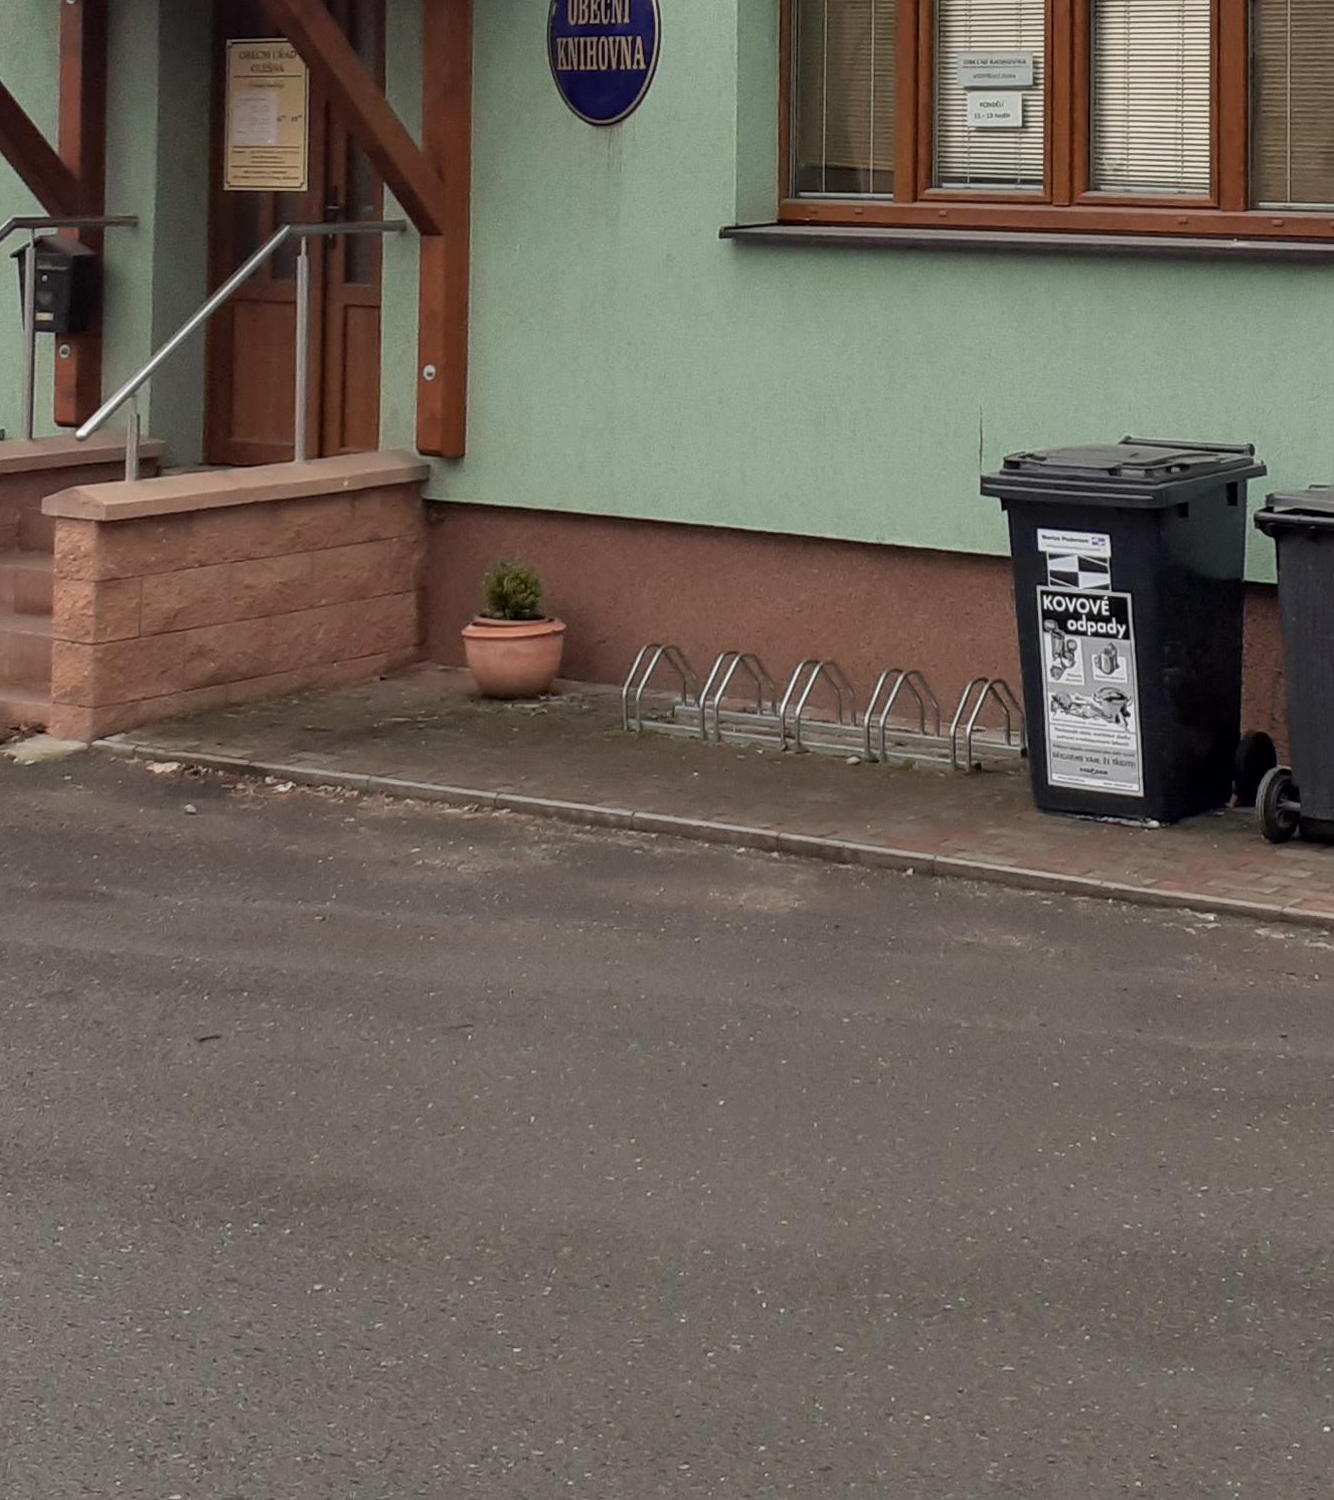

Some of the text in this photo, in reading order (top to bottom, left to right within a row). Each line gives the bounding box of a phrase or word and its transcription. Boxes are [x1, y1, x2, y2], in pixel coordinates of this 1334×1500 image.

[556, 35, 647, 71] KNIHOVNA
[1042, 595, 1110, 616] KOVOVÉ
[1067, 614, 1127, 639] odpady
